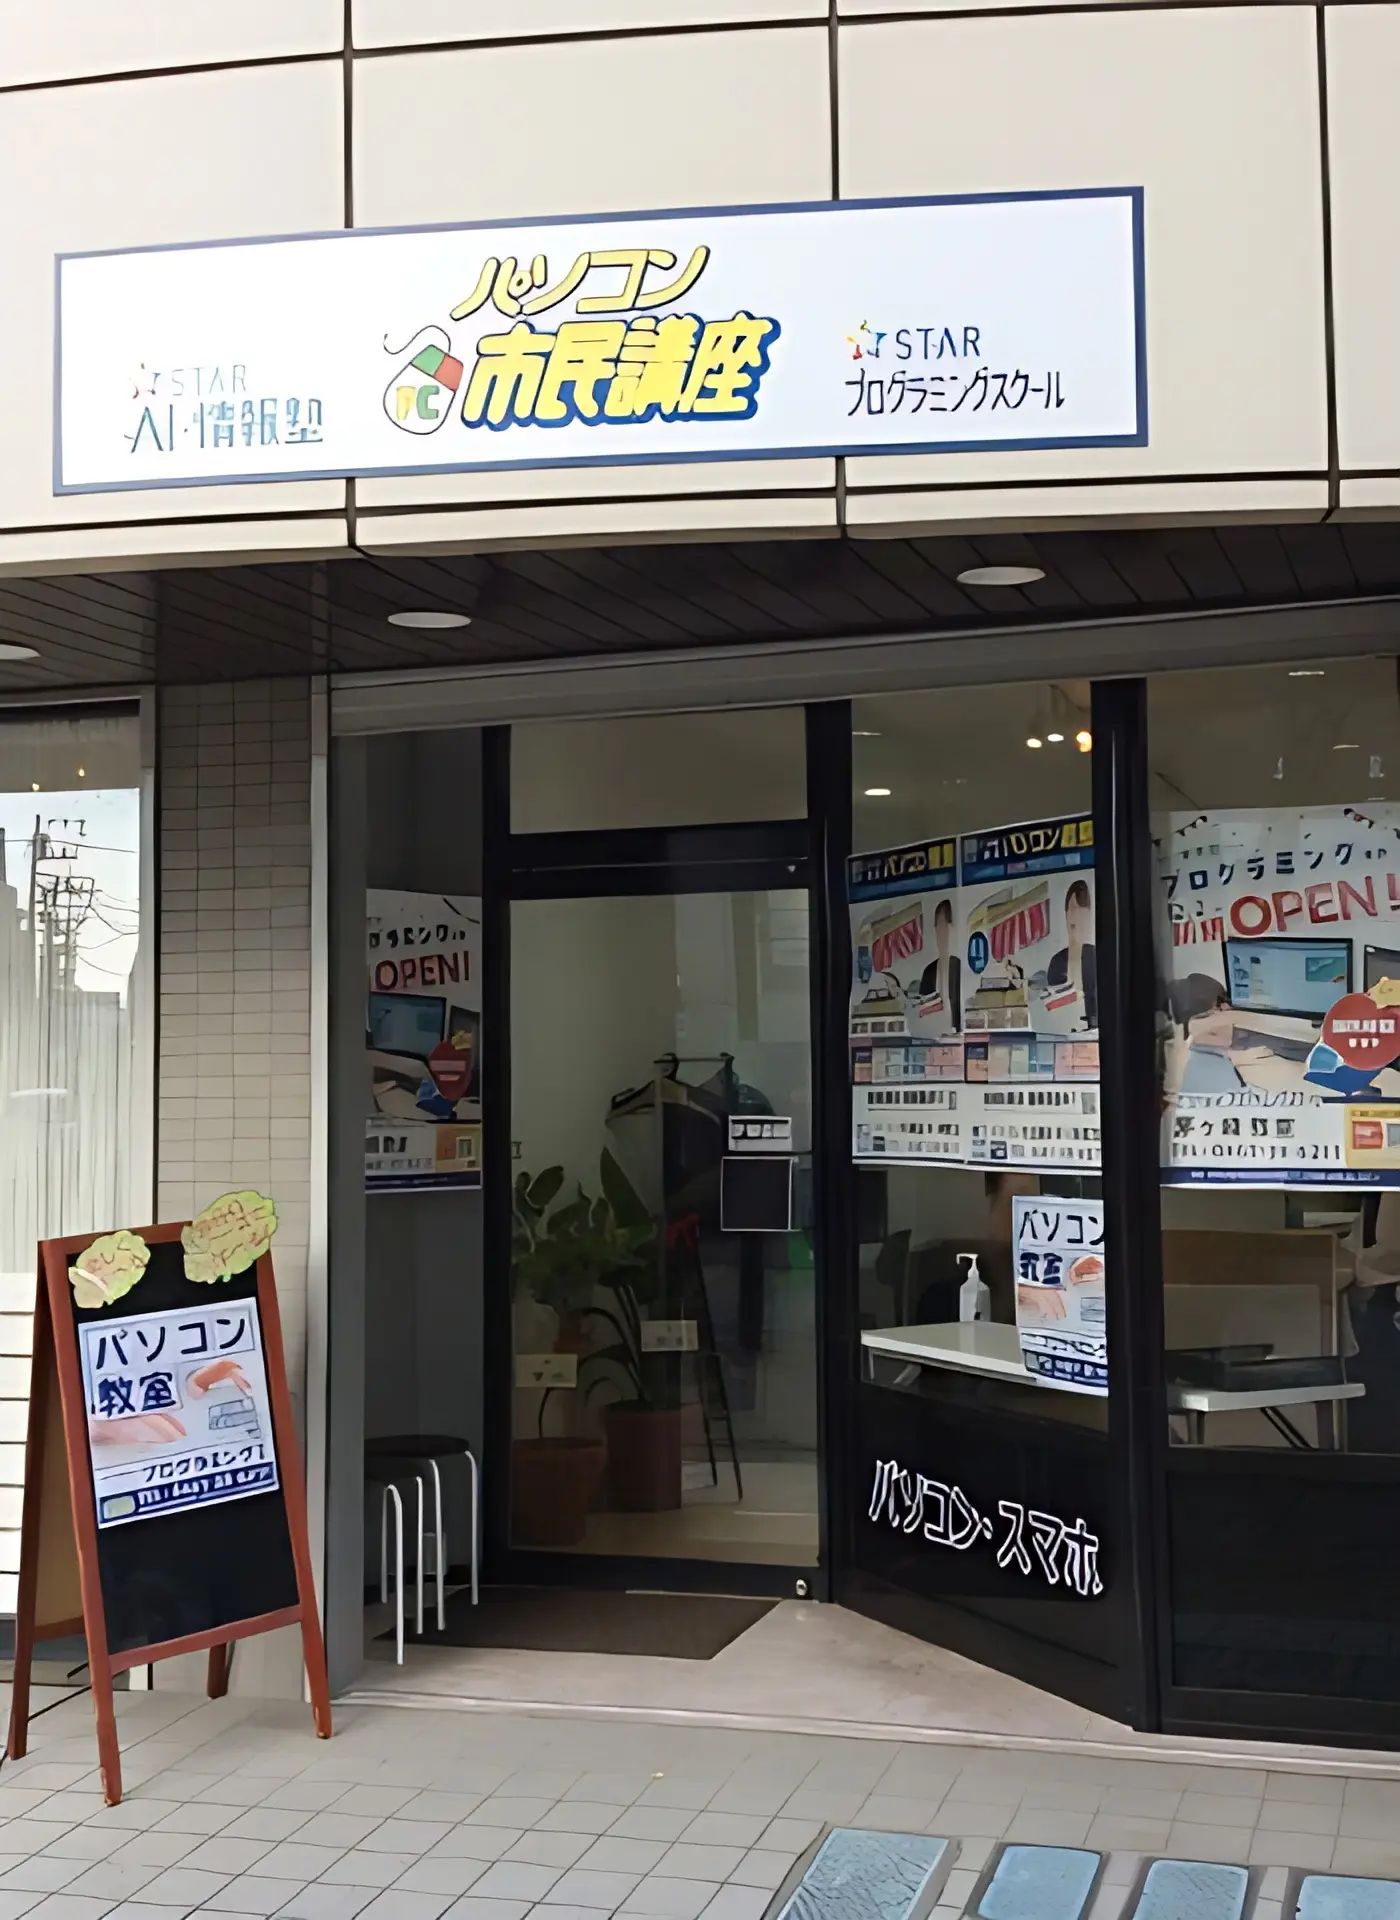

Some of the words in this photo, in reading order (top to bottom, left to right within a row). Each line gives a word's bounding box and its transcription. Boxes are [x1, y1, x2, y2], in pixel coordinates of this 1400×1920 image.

[449, 246, 712, 322] パソコン
[895, 326, 982, 360] STAR
[171, 364, 247, 396] STAR
[459, 311, 782, 432] 市民講座
[845, 366, 1066, 417] プログラミングスクール
[95, 1318, 246, 1370] パソコン
